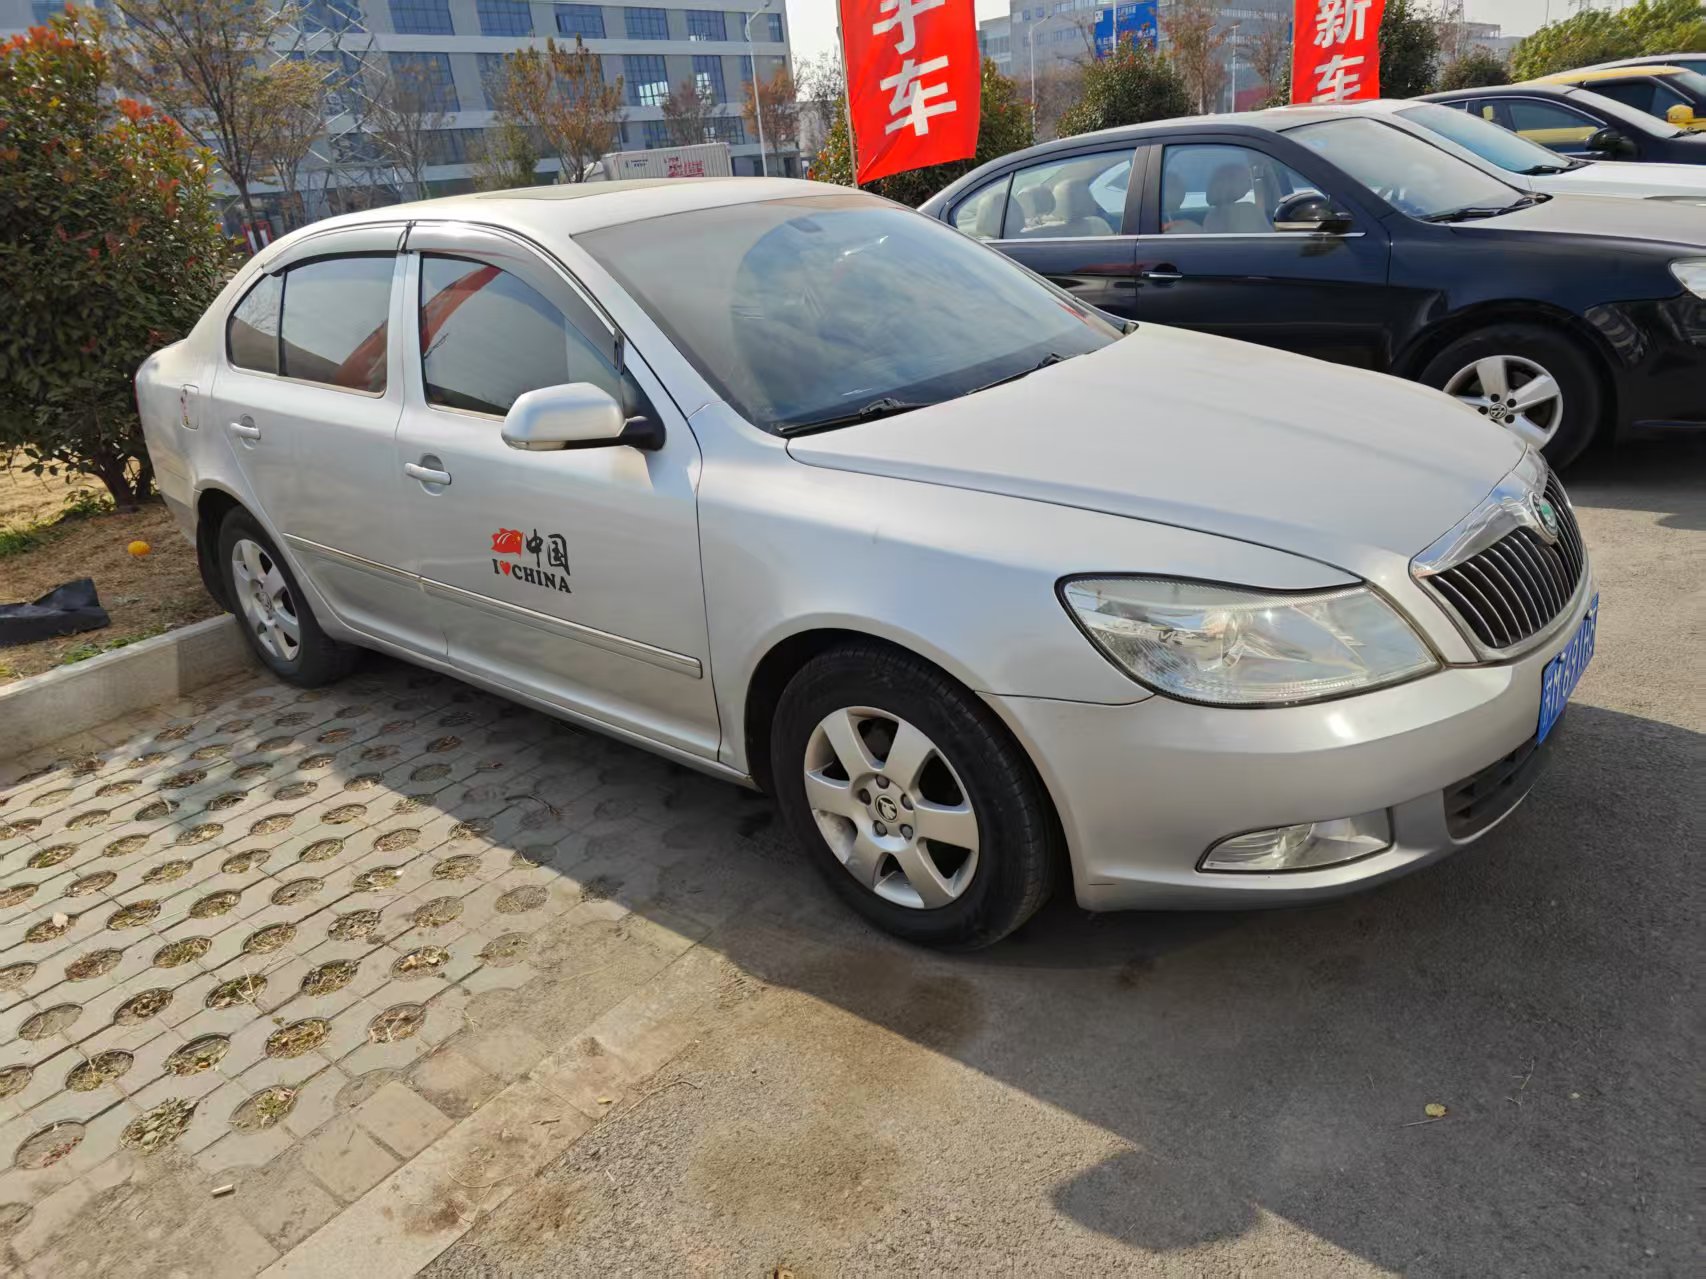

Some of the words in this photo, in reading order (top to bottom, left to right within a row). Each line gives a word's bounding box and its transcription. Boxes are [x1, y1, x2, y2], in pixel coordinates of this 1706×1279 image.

[871, 0, 957, 136] 手车
[1312, 0, 1372, 103] 新车
[491, 558, 500, 575] I
[511, 564, 572, 594] CHINA
[525, 528, 571, 576] 中国
